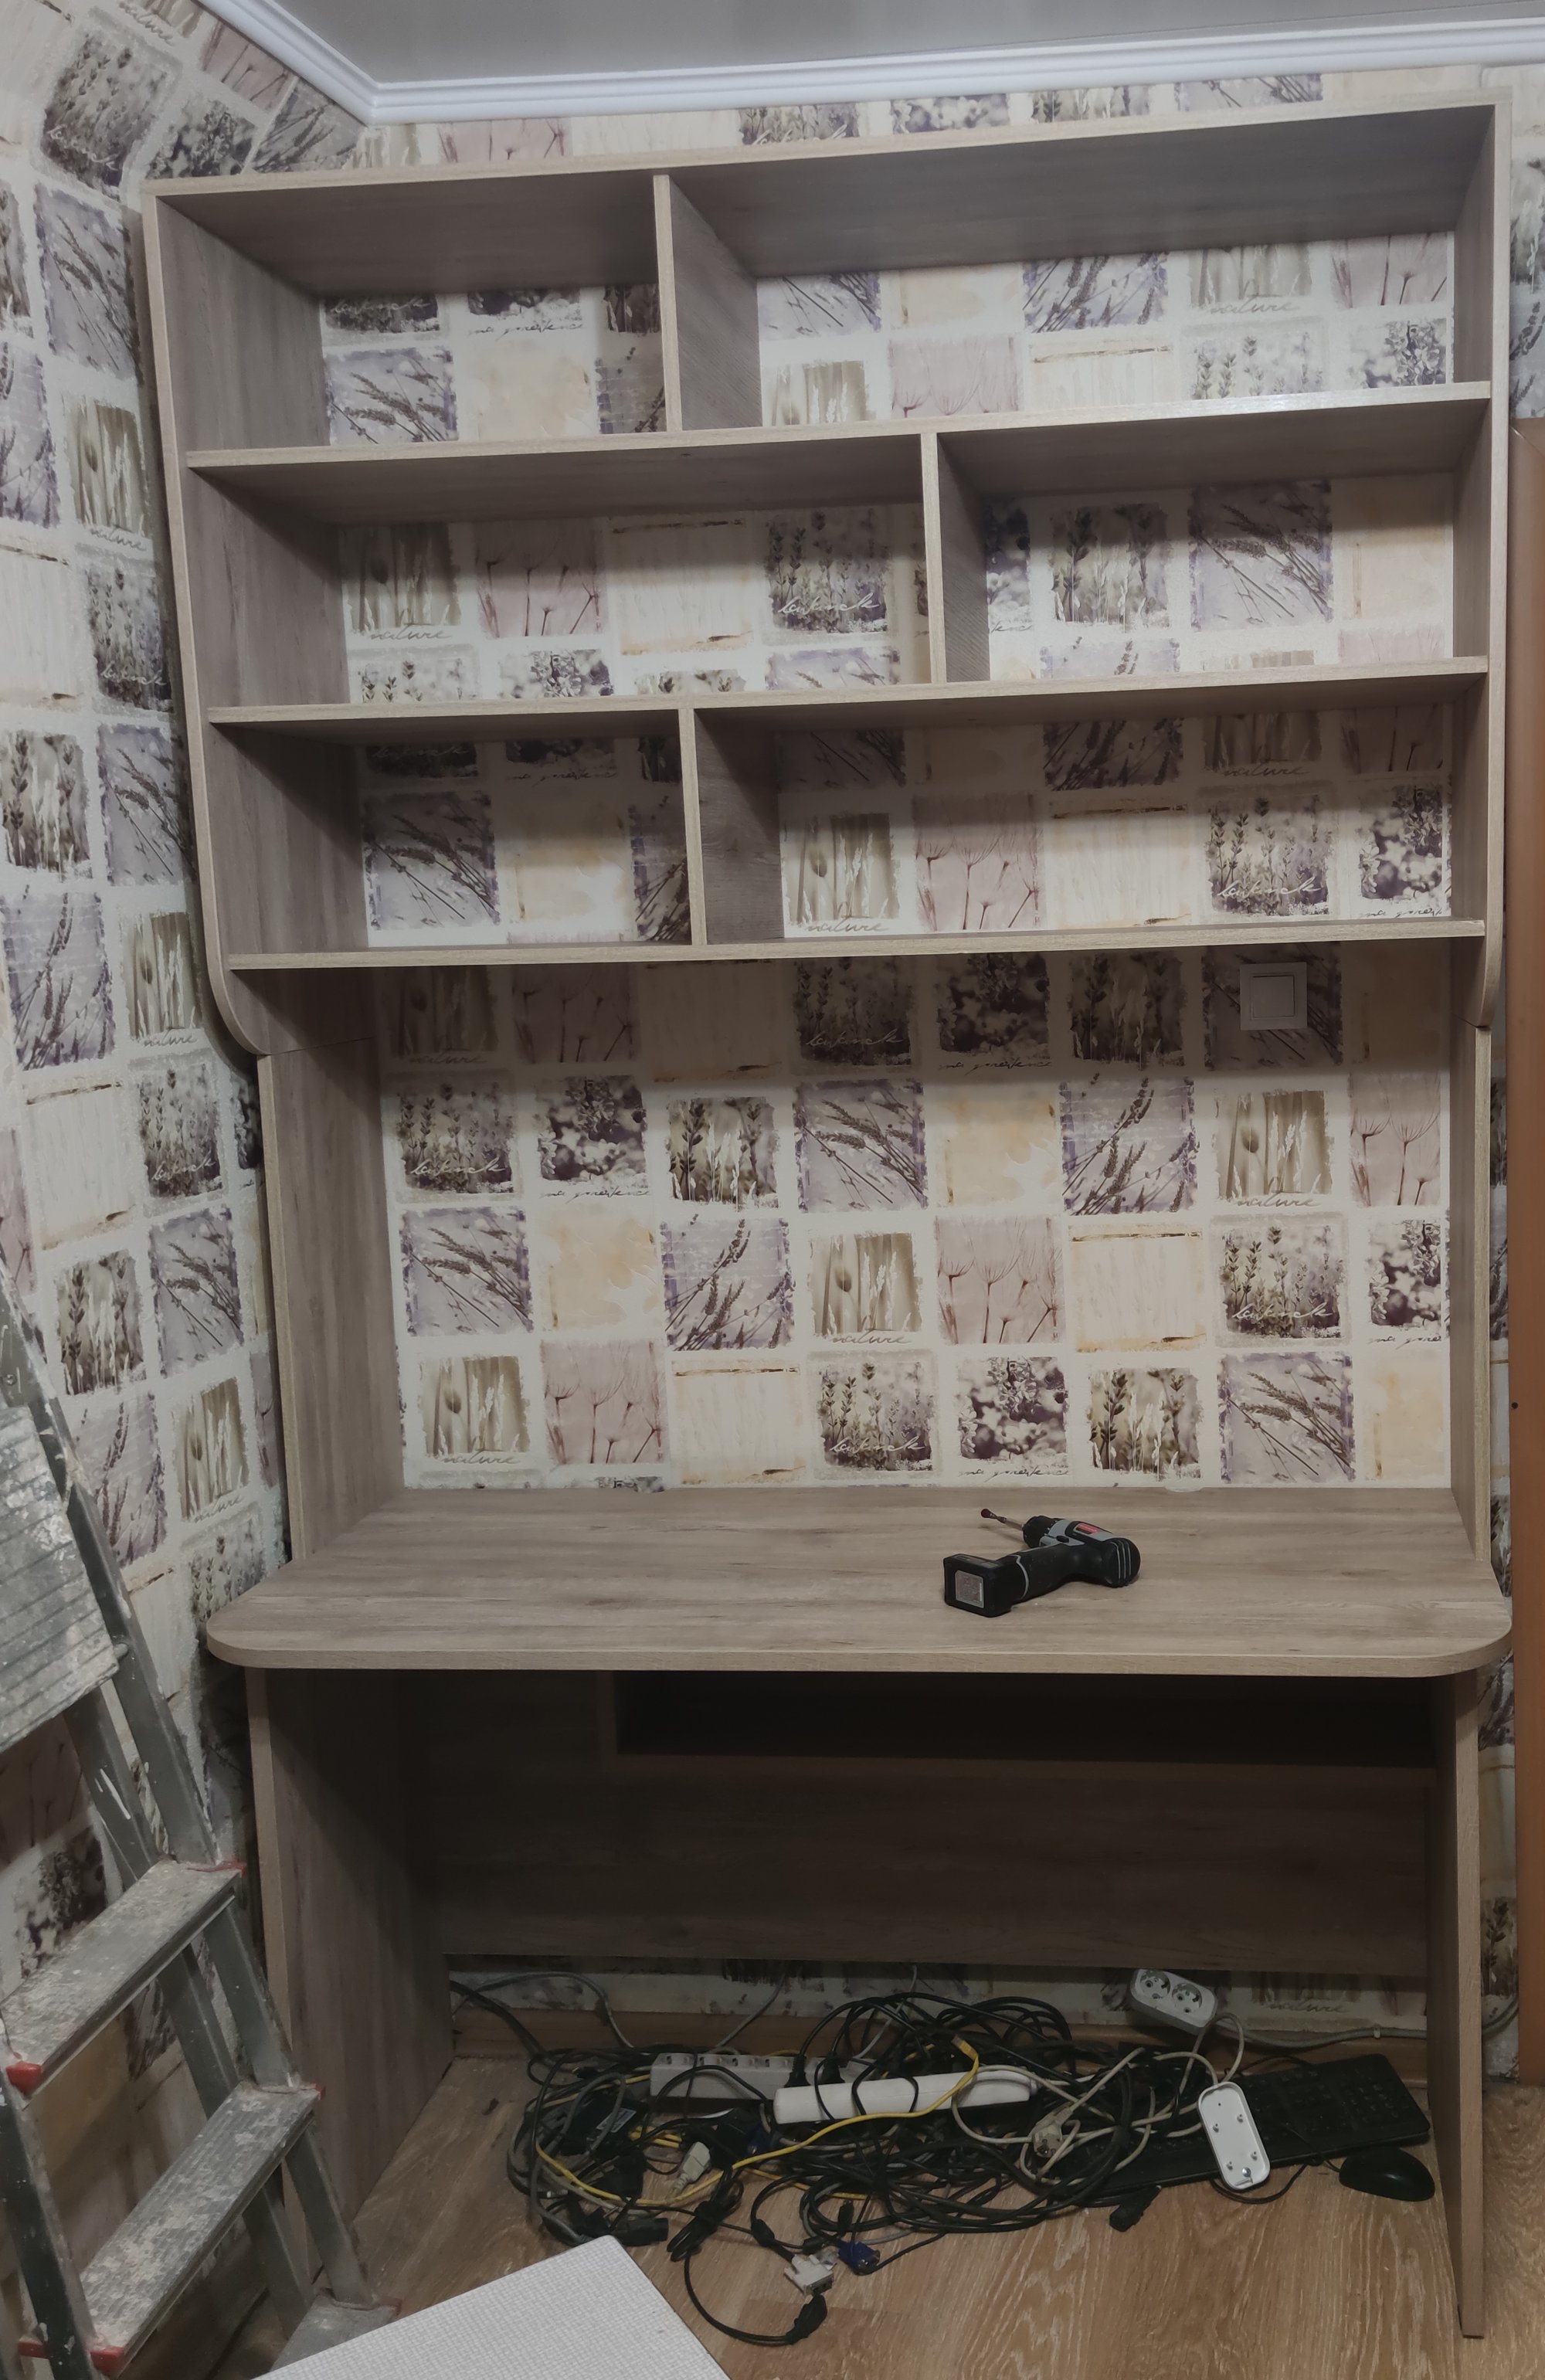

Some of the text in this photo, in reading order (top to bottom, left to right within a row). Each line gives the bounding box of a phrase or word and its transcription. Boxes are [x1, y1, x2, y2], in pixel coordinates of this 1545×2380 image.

[371, 623, 452, 641] nature
[808, 916, 888, 932] nature
[1236, 1190, 1321, 1207] nature
[831, 1328, 913, 1344] nature
[443, 1448, 521, 1465] nature
